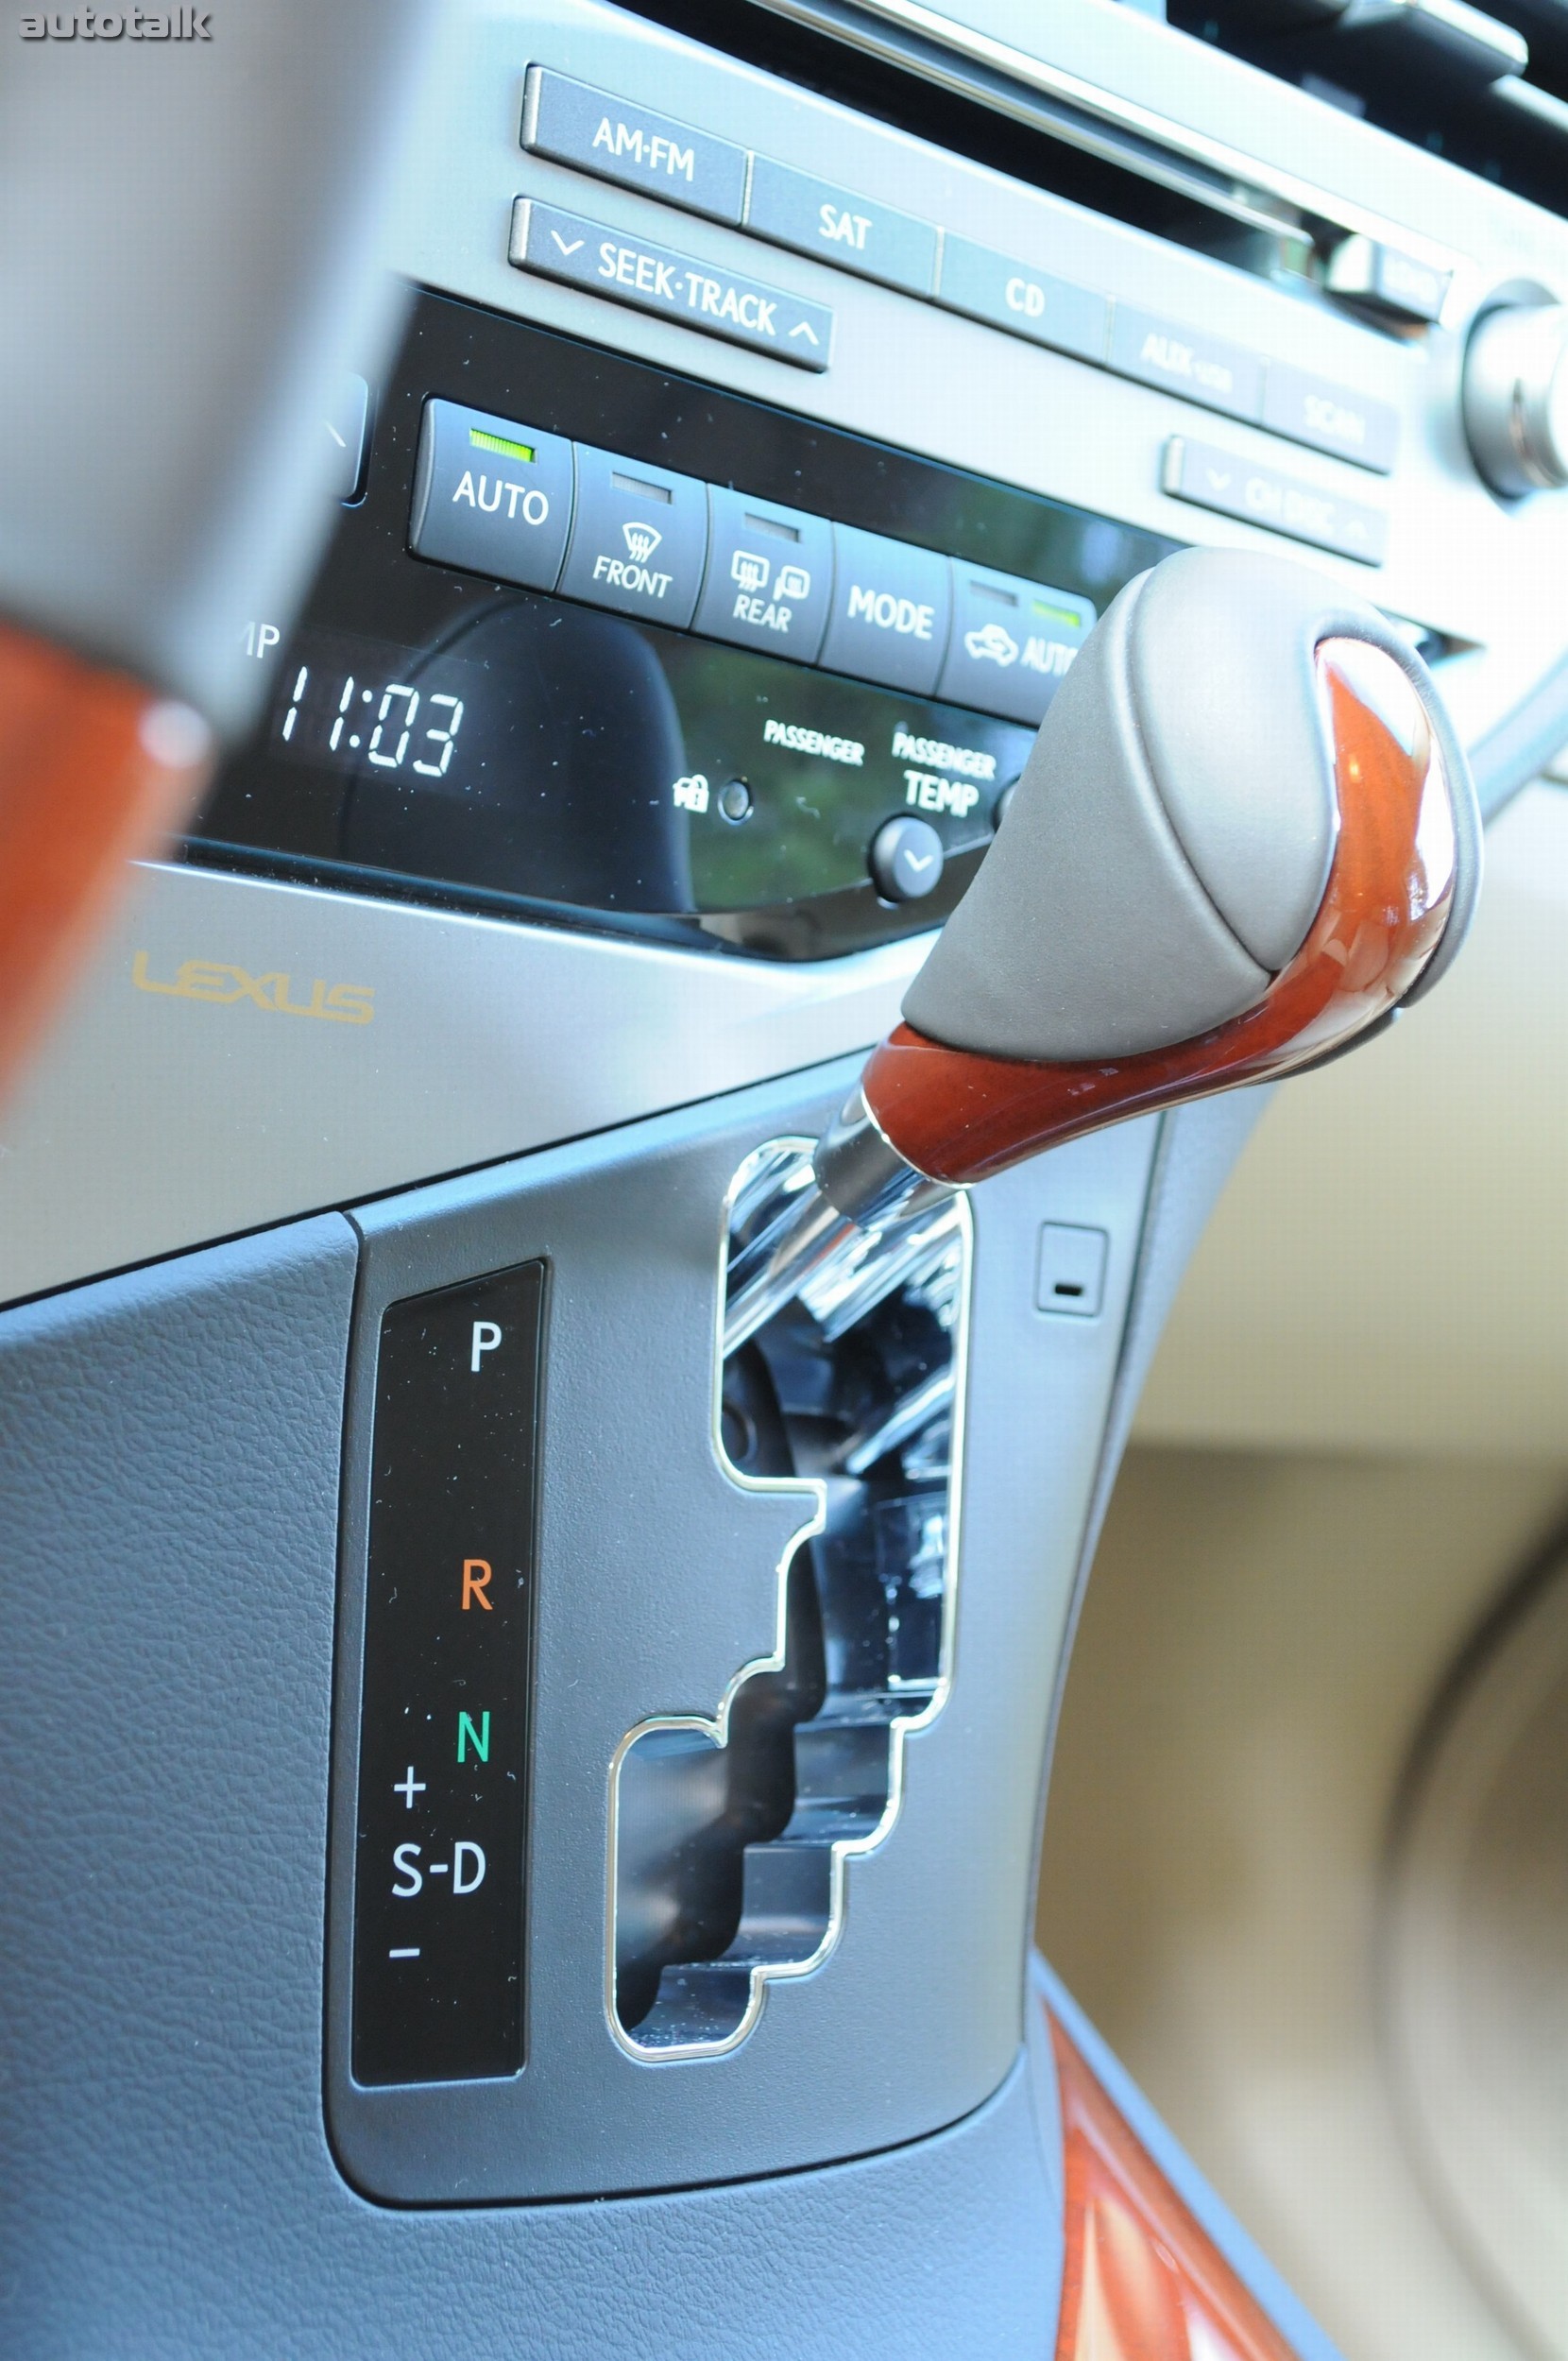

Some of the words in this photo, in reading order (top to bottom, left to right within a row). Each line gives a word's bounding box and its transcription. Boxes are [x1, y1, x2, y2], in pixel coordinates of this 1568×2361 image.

[818, 204, 873, 250] SAT
[1005, 277, 1046, 317] CD
[452, 470, 550, 526] AUTO
[592, 555, 674, 599] FRONT
[733, 593, 793, 634] REAR
[847, 585, 935, 642] MODE
[282, 665, 464, 778] 11:03
[763, 719, 866, 767] PASSENGER
[891, 731, 997, 781] PASSENGER
[903, 769, 980, 819] TEMP
[132, 950, 375, 1025] LEXUS
[470, 1320, 503, 1373] P
[461, 1558, 493, 1611] R
[456, 1710, 490, 1763] N
